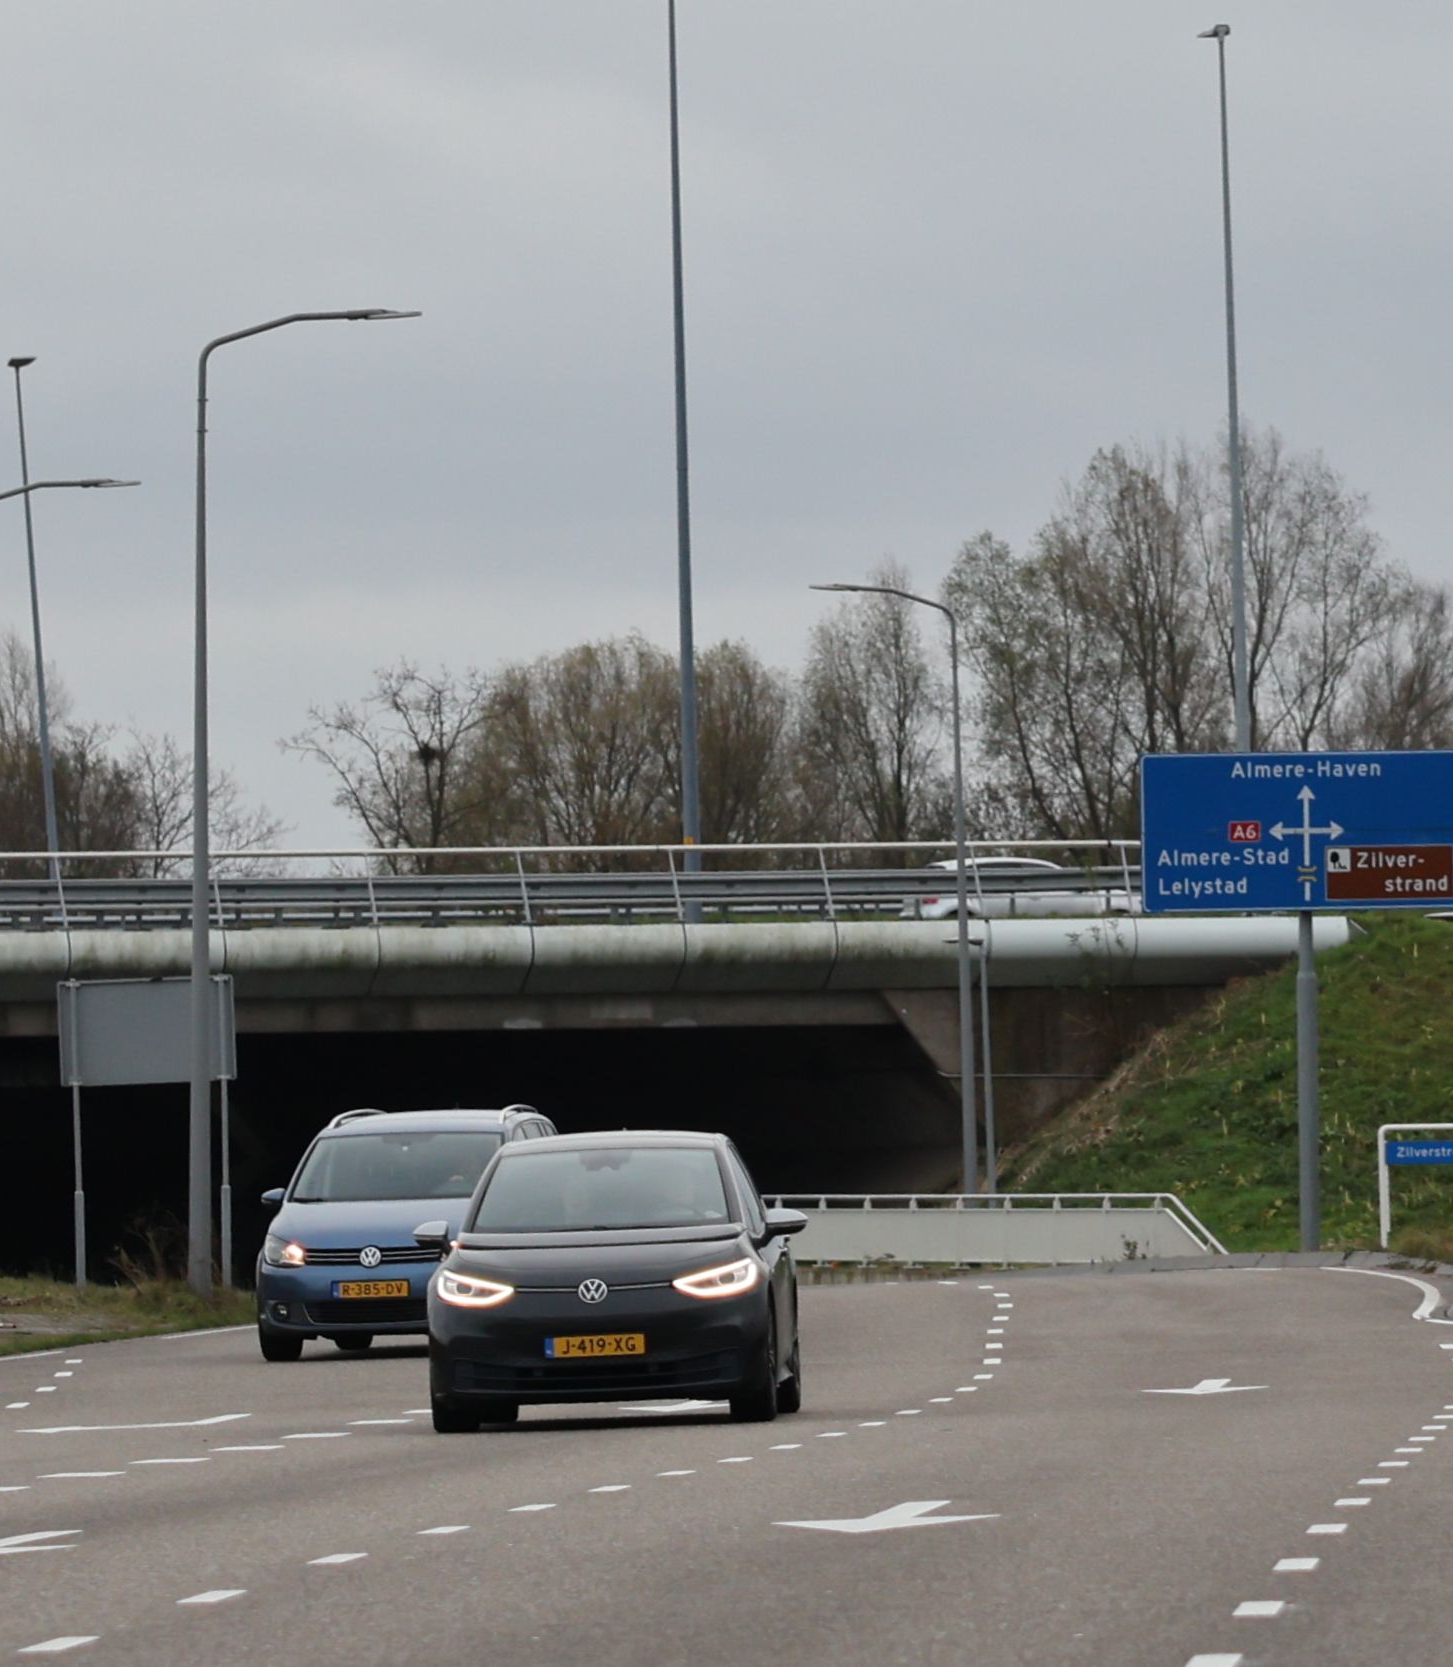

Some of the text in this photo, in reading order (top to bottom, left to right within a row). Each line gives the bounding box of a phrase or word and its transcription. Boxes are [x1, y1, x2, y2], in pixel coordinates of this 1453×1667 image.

[1231, 761, 1382, 779] Almere-Haven
[1233, 824, 1256, 840] A6
[1157, 848, 1290, 866] Almere-Stad
[1357, 852, 1425, 868] Zilver-
[1158, 877, 1248, 897] Lelystad
[1384, 876, 1448, 893] strand
[1396, 1146, 1453, 1158] Zilverstr
[342, 1283, 404, 1296] R-385-DV
[563, 1337, 636, 1355] J-419-XG
